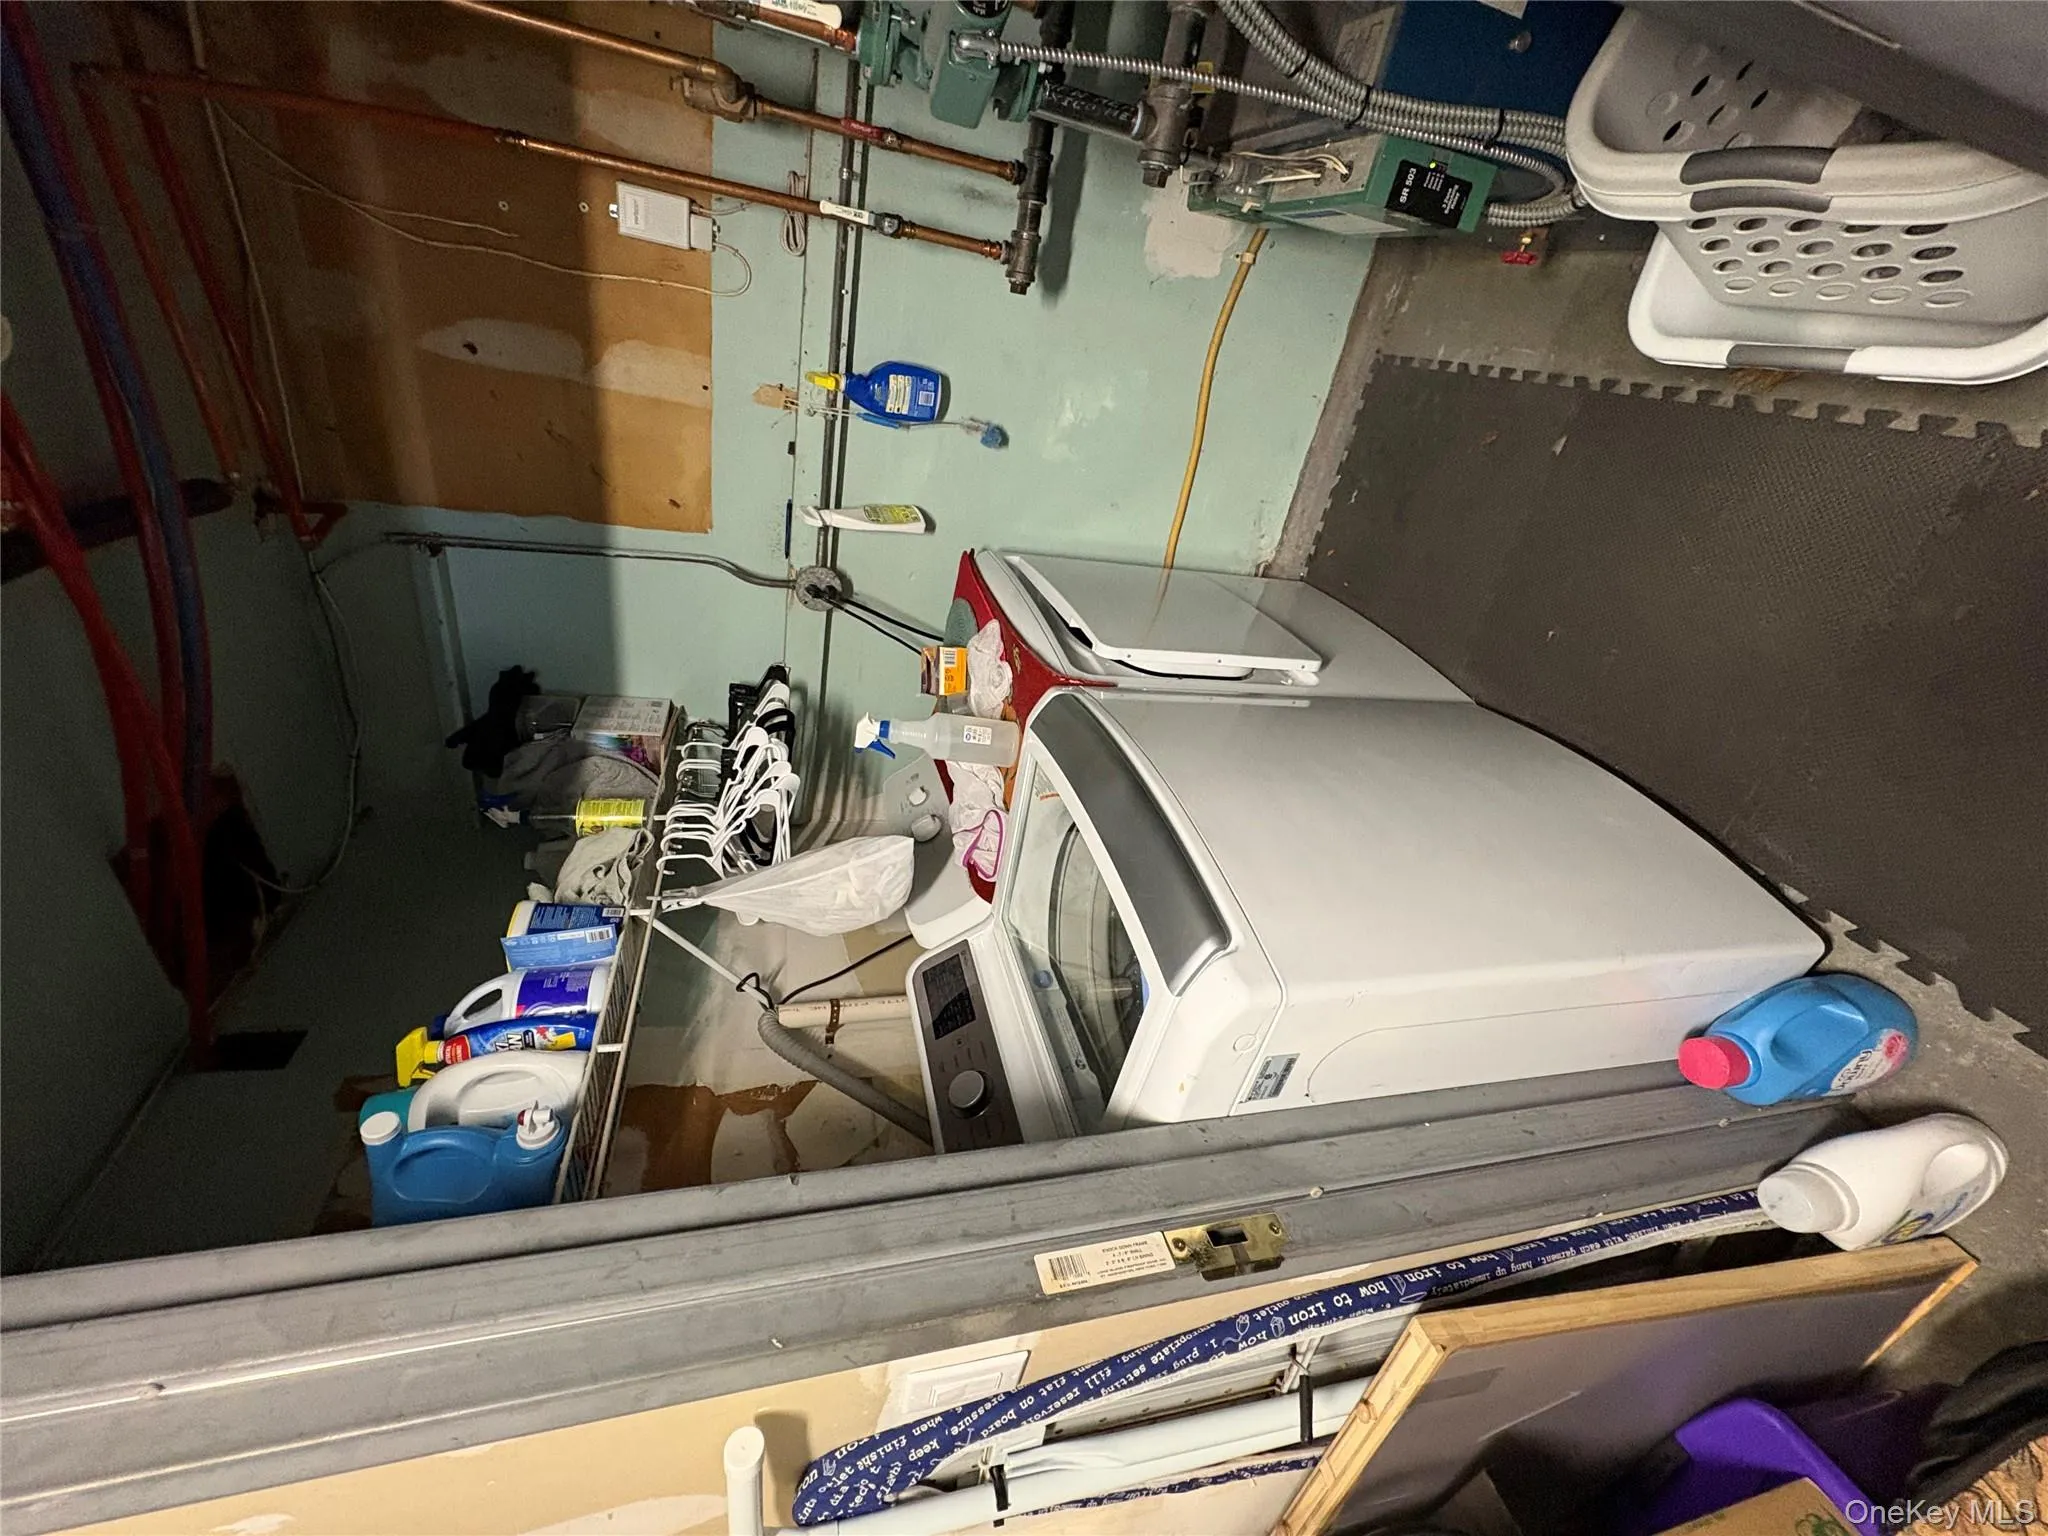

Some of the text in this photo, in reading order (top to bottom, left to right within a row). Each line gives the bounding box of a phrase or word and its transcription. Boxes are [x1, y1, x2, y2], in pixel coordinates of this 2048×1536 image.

[1405, 167, 1417, 187] 503
[1404, 1265, 1443, 1283] iron
[1446, 1261, 1466, 1271] to
[1495, 1266, 1508, 1276] up
[1510, 1259, 1533, 1273] hang
[1359, 1280, 1390, 1298] how
[1333, 1293, 1353, 1307] to
[1288, 1300, 1327, 1327] iron
[1238, 1329, 1268, 1351] how
[1172, 1346, 1200, 1370] plug
[1038, 1376, 1067, 1396] flat
[1084, 1366, 1112, 1390] fill
[1018, 1396, 1035, 1410] on
[912, 1415, 943, 1436] when
[981, 1408, 1018, 1439] board
[908, 1438, 940, 1461] keep
